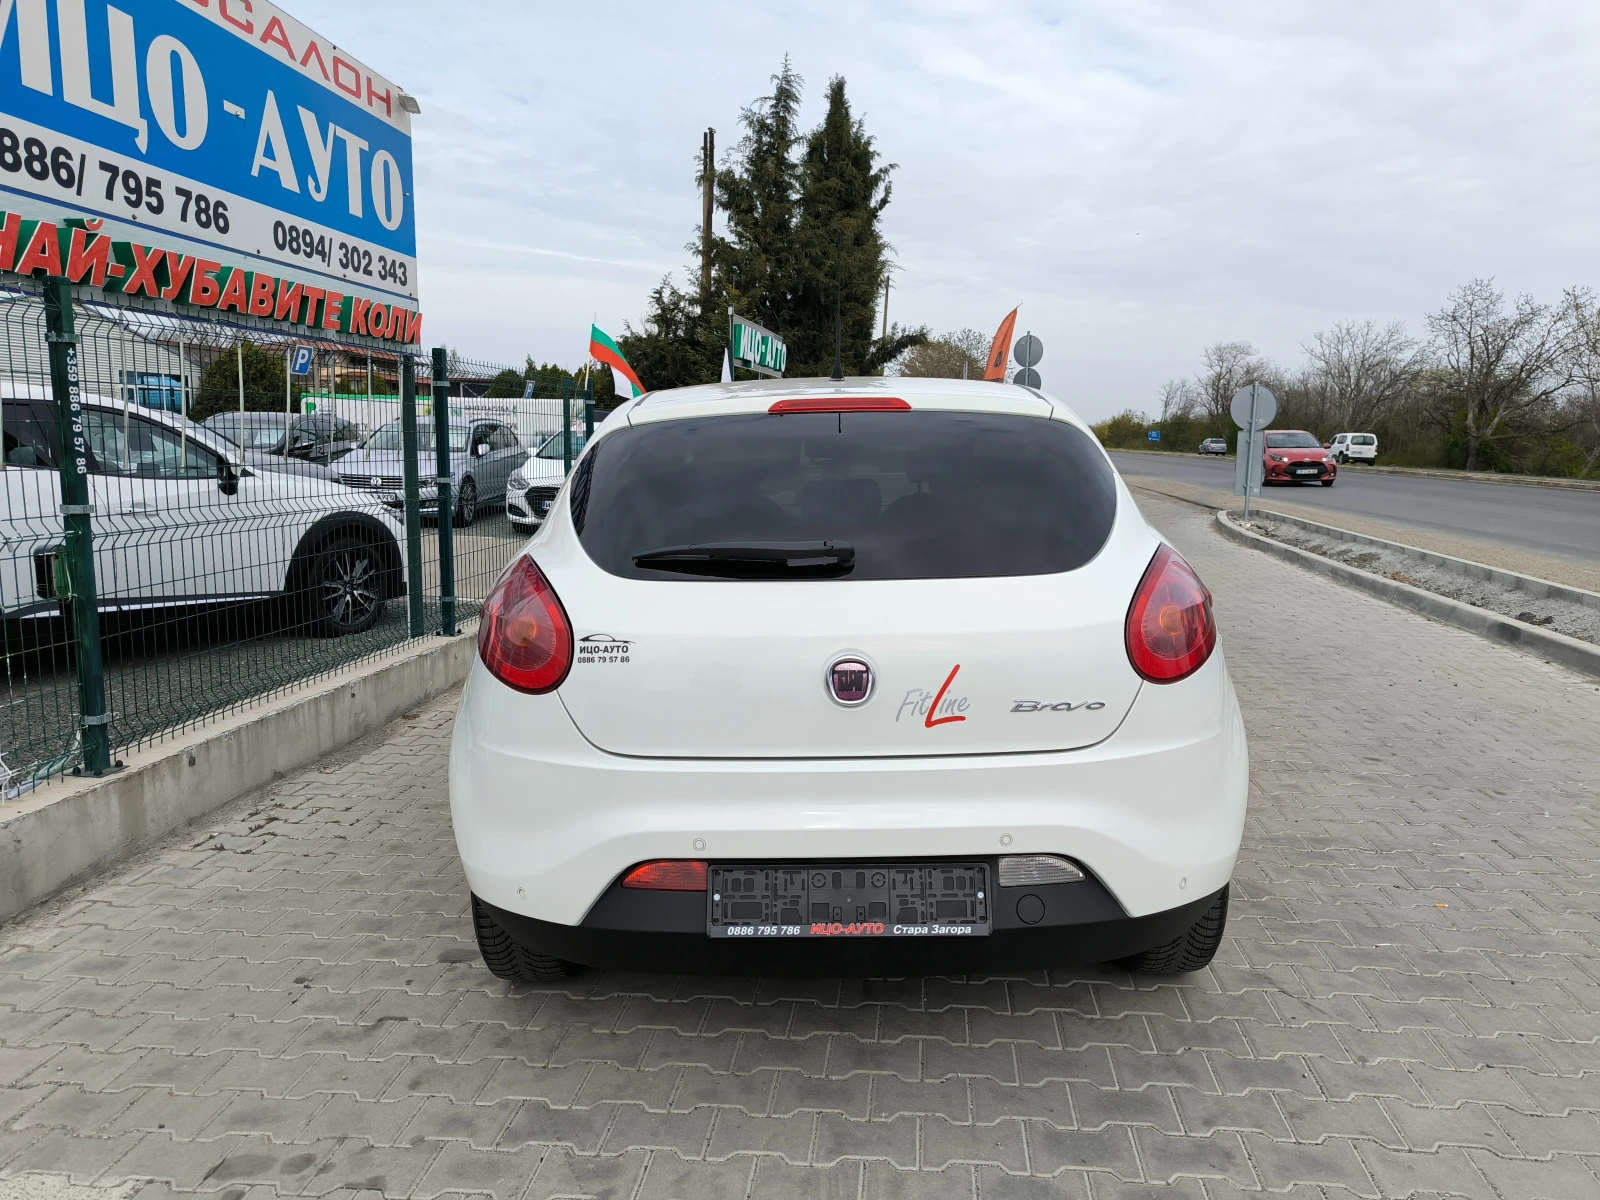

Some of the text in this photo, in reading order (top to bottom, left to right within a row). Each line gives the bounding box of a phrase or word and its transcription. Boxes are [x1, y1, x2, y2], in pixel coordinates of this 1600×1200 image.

[192, 0, 392, 118] САЛОН
[98, 159, 164, 215] 795
[174, 185, 230, 235] 786
[273, 220, 408, 286] 0894/ 302 343
[350, 296, 423, 345] КОЛИ
[295, 349, 309, 371] P
[739, 323, 787, 372] ИЦО-АУТО
[66, 347, 87, 474] +359 886 79 57 86
[579, 645, 629, 655] ИЦО-АУТО
[895, 663, 971, 728] FitLine
[1010, 698, 1106, 713] Bravo
[727, 923, 972, 936] 0886 795 786 ИЦО-АУТО Стара Загора
